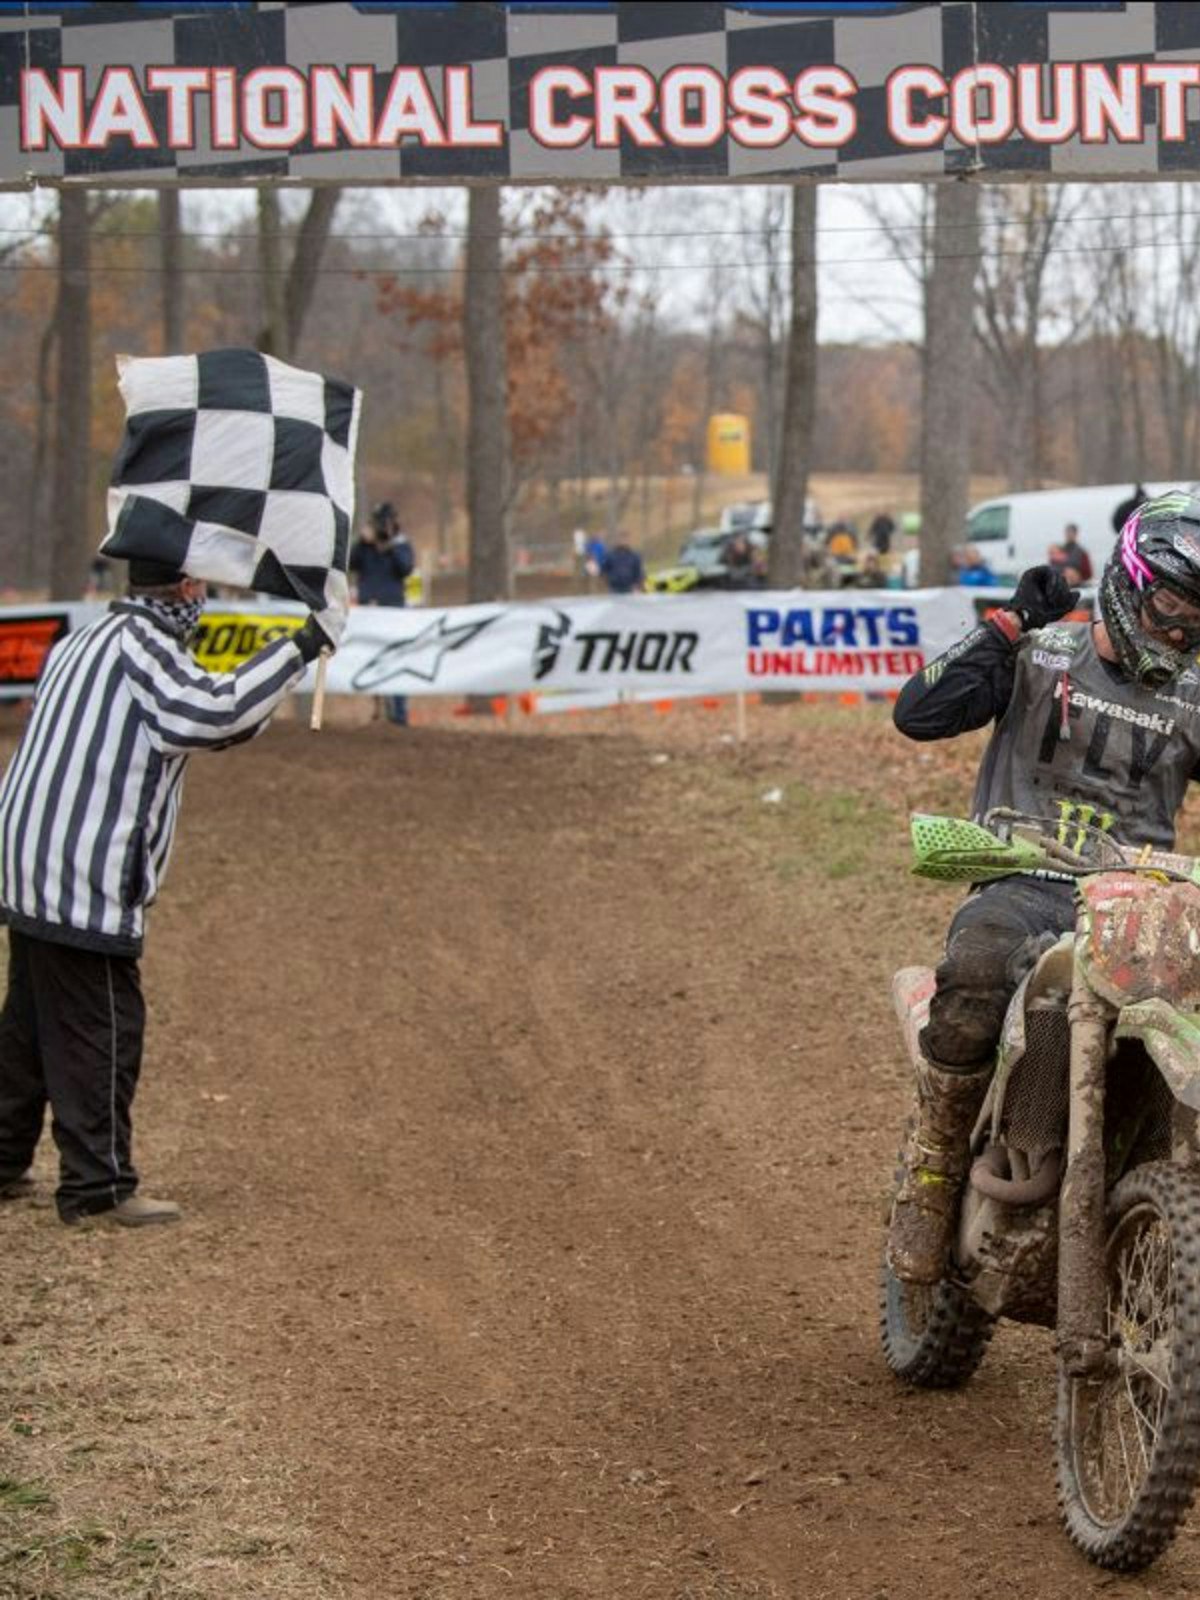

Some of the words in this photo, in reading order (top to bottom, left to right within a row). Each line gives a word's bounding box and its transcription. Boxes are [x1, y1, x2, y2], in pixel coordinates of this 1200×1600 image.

[21, 65, 504, 150] NATIONAL
[528, 62, 857, 149] CROSS
[747, 608, 920, 647] PARTS
[575, 632, 699, 673] THOR
[748, 651, 925, 677] UNLIMITED
[1054, 681, 1175, 735] Kawasaki
